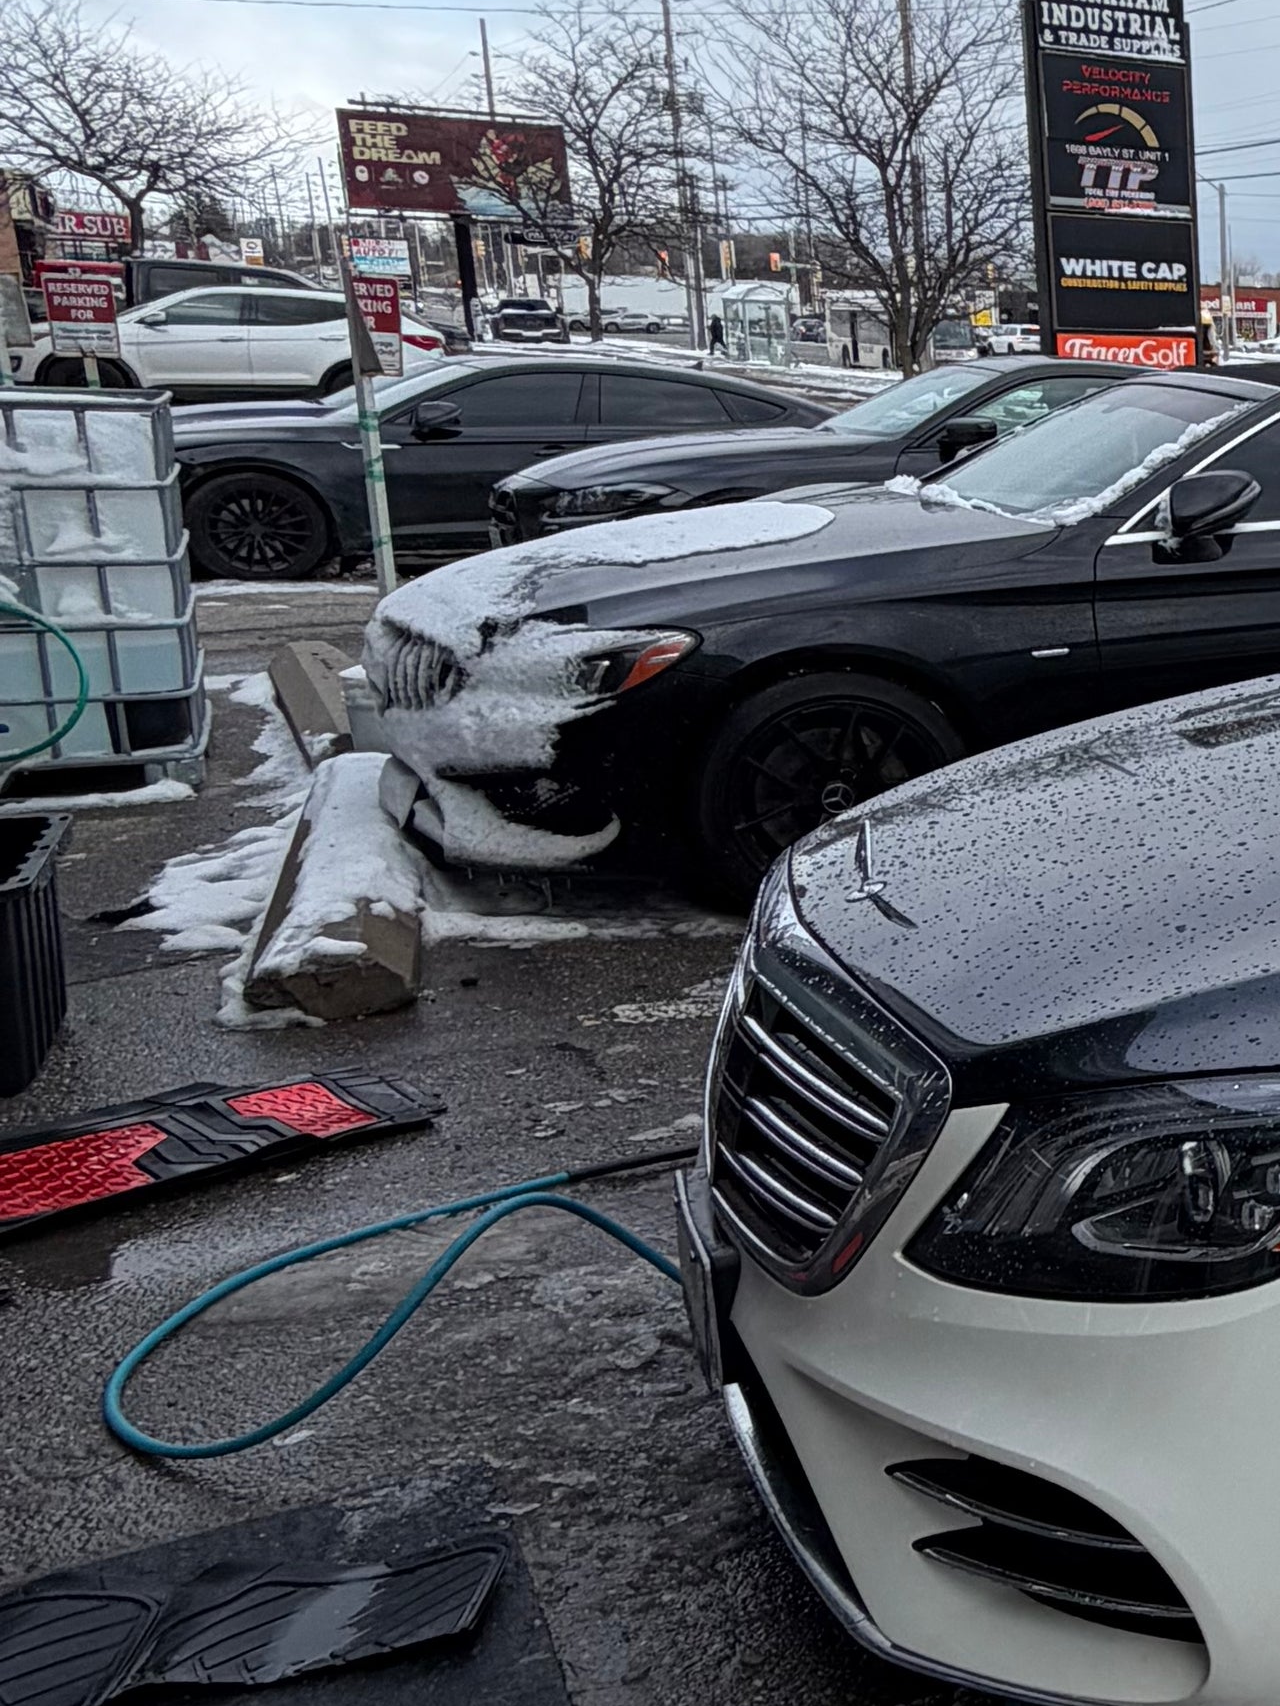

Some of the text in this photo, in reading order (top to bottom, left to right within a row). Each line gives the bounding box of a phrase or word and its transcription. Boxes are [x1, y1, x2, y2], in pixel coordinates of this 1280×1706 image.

[1040, 1, 1180, 41] INDUSTRIAL
[1043, 28, 1181, 58] & TRADE SUPPLIES
[1081, 64, 1151, 85] VELOCITY
[1062, 79, 1171, 103] PERFORMANCE
[348, 119, 408, 136] FEED
[351, 133, 397, 149] THE
[352, 146, 441, 165] DREAM
[1088, 145, 1120, 158] BAYLY
[1140, 150, 1162, 162] UNIT
[1060, 257, 1138, 279] WHITE
[47, 282, 110, 295] RESERVED
[53, 295, 108, 308] PARKING
[70, 309, 94, 320] FOR
